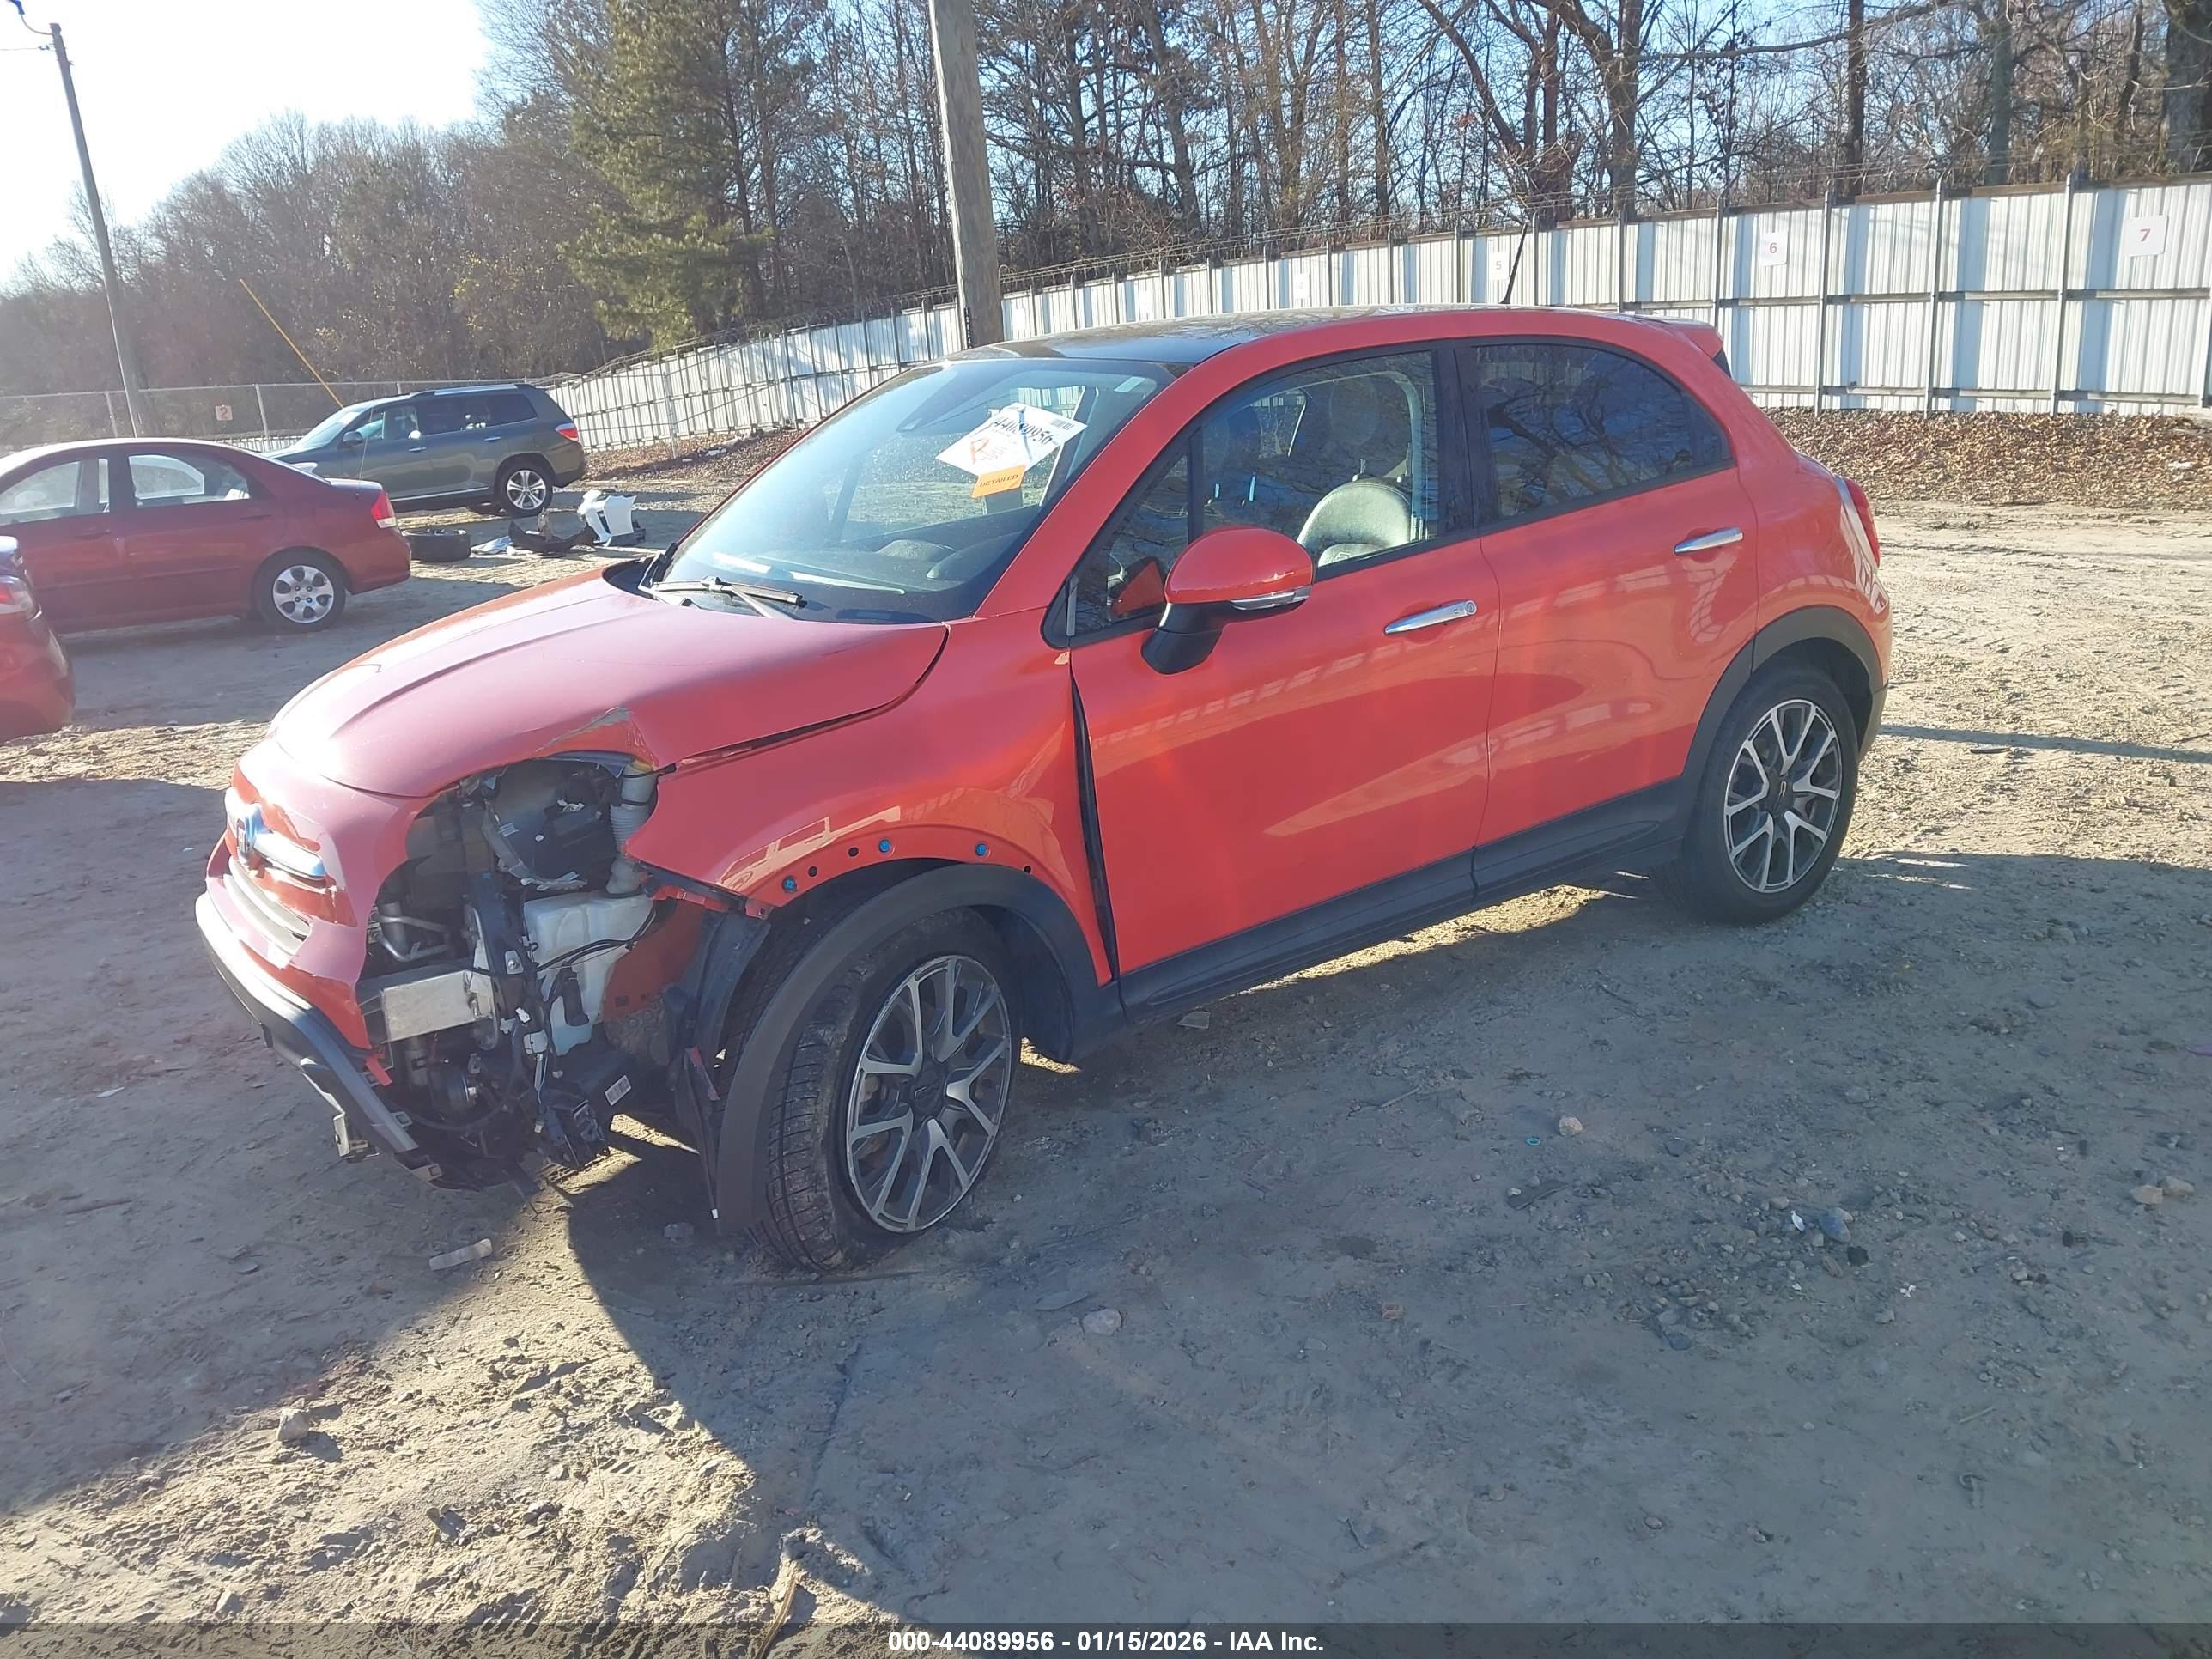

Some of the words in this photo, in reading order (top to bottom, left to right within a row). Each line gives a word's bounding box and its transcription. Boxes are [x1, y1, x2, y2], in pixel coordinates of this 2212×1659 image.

[2140, 228, 2151, 242] 7
[1769, 242, 1778, 254] 6
[1496, 260, 1502, 270] 5
[220, 406, 228, 419] 2
[980, 474, 1018, 487] DETAILED
